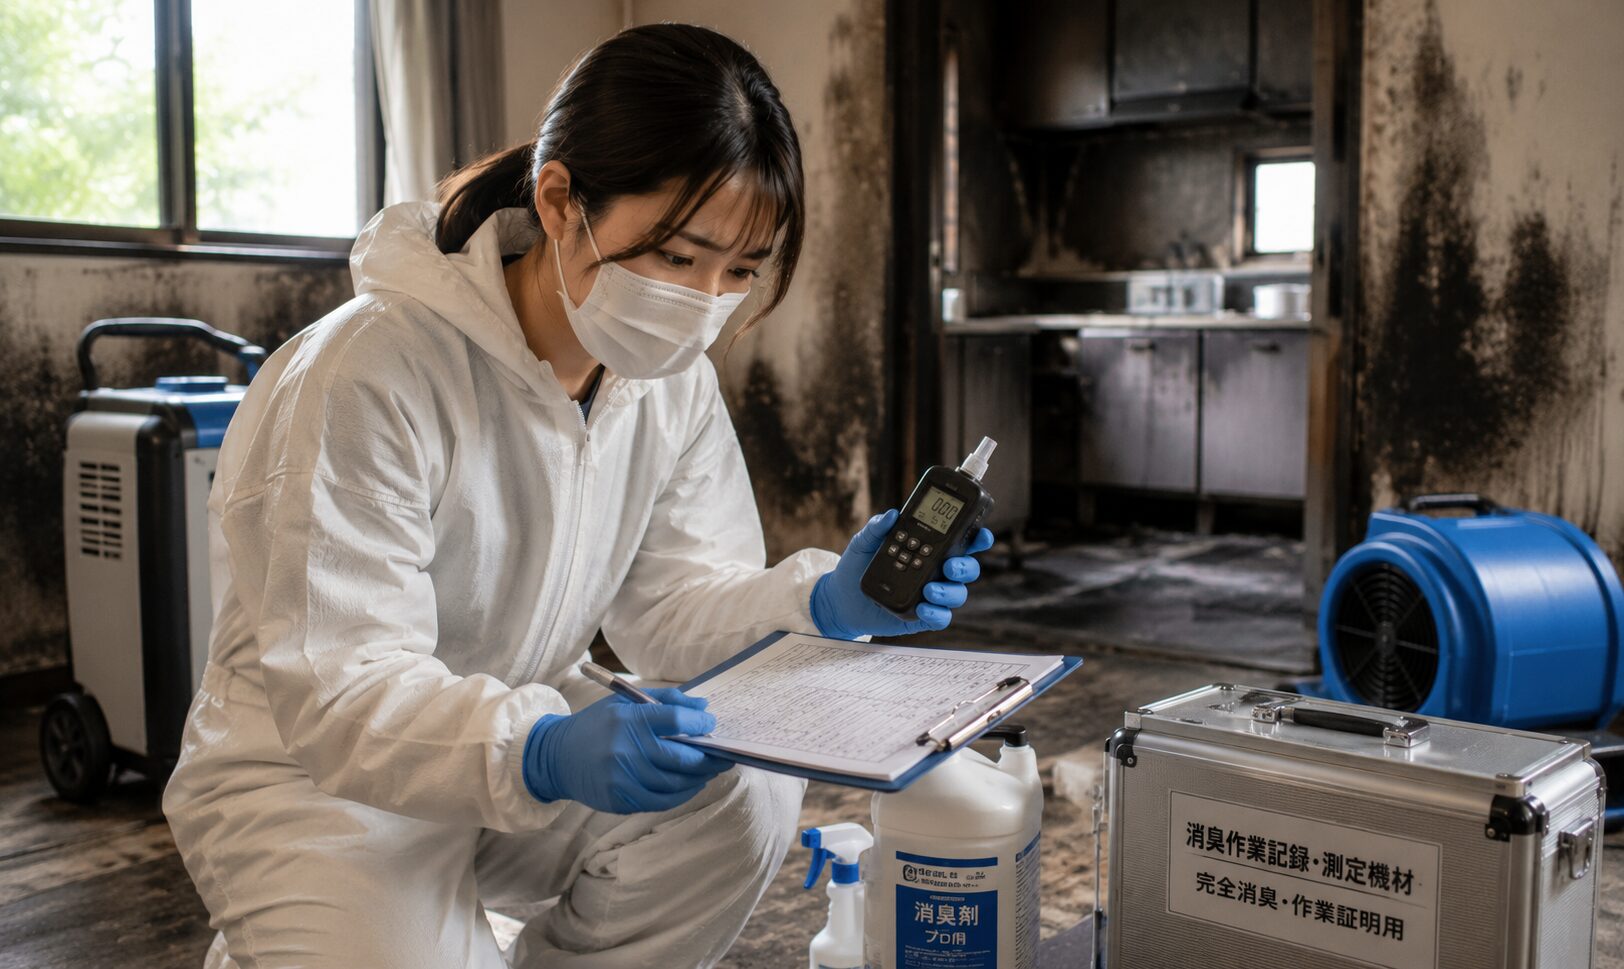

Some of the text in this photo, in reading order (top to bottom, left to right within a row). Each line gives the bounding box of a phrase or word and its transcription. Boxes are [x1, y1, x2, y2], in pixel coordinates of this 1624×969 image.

[1186, 821, 1414, 896] 消臭作業記録・測定機材
[914, 901, 979, 926] 消臭剤
[1196, 871, 1404, 941] 完全消臭・作業証明用
